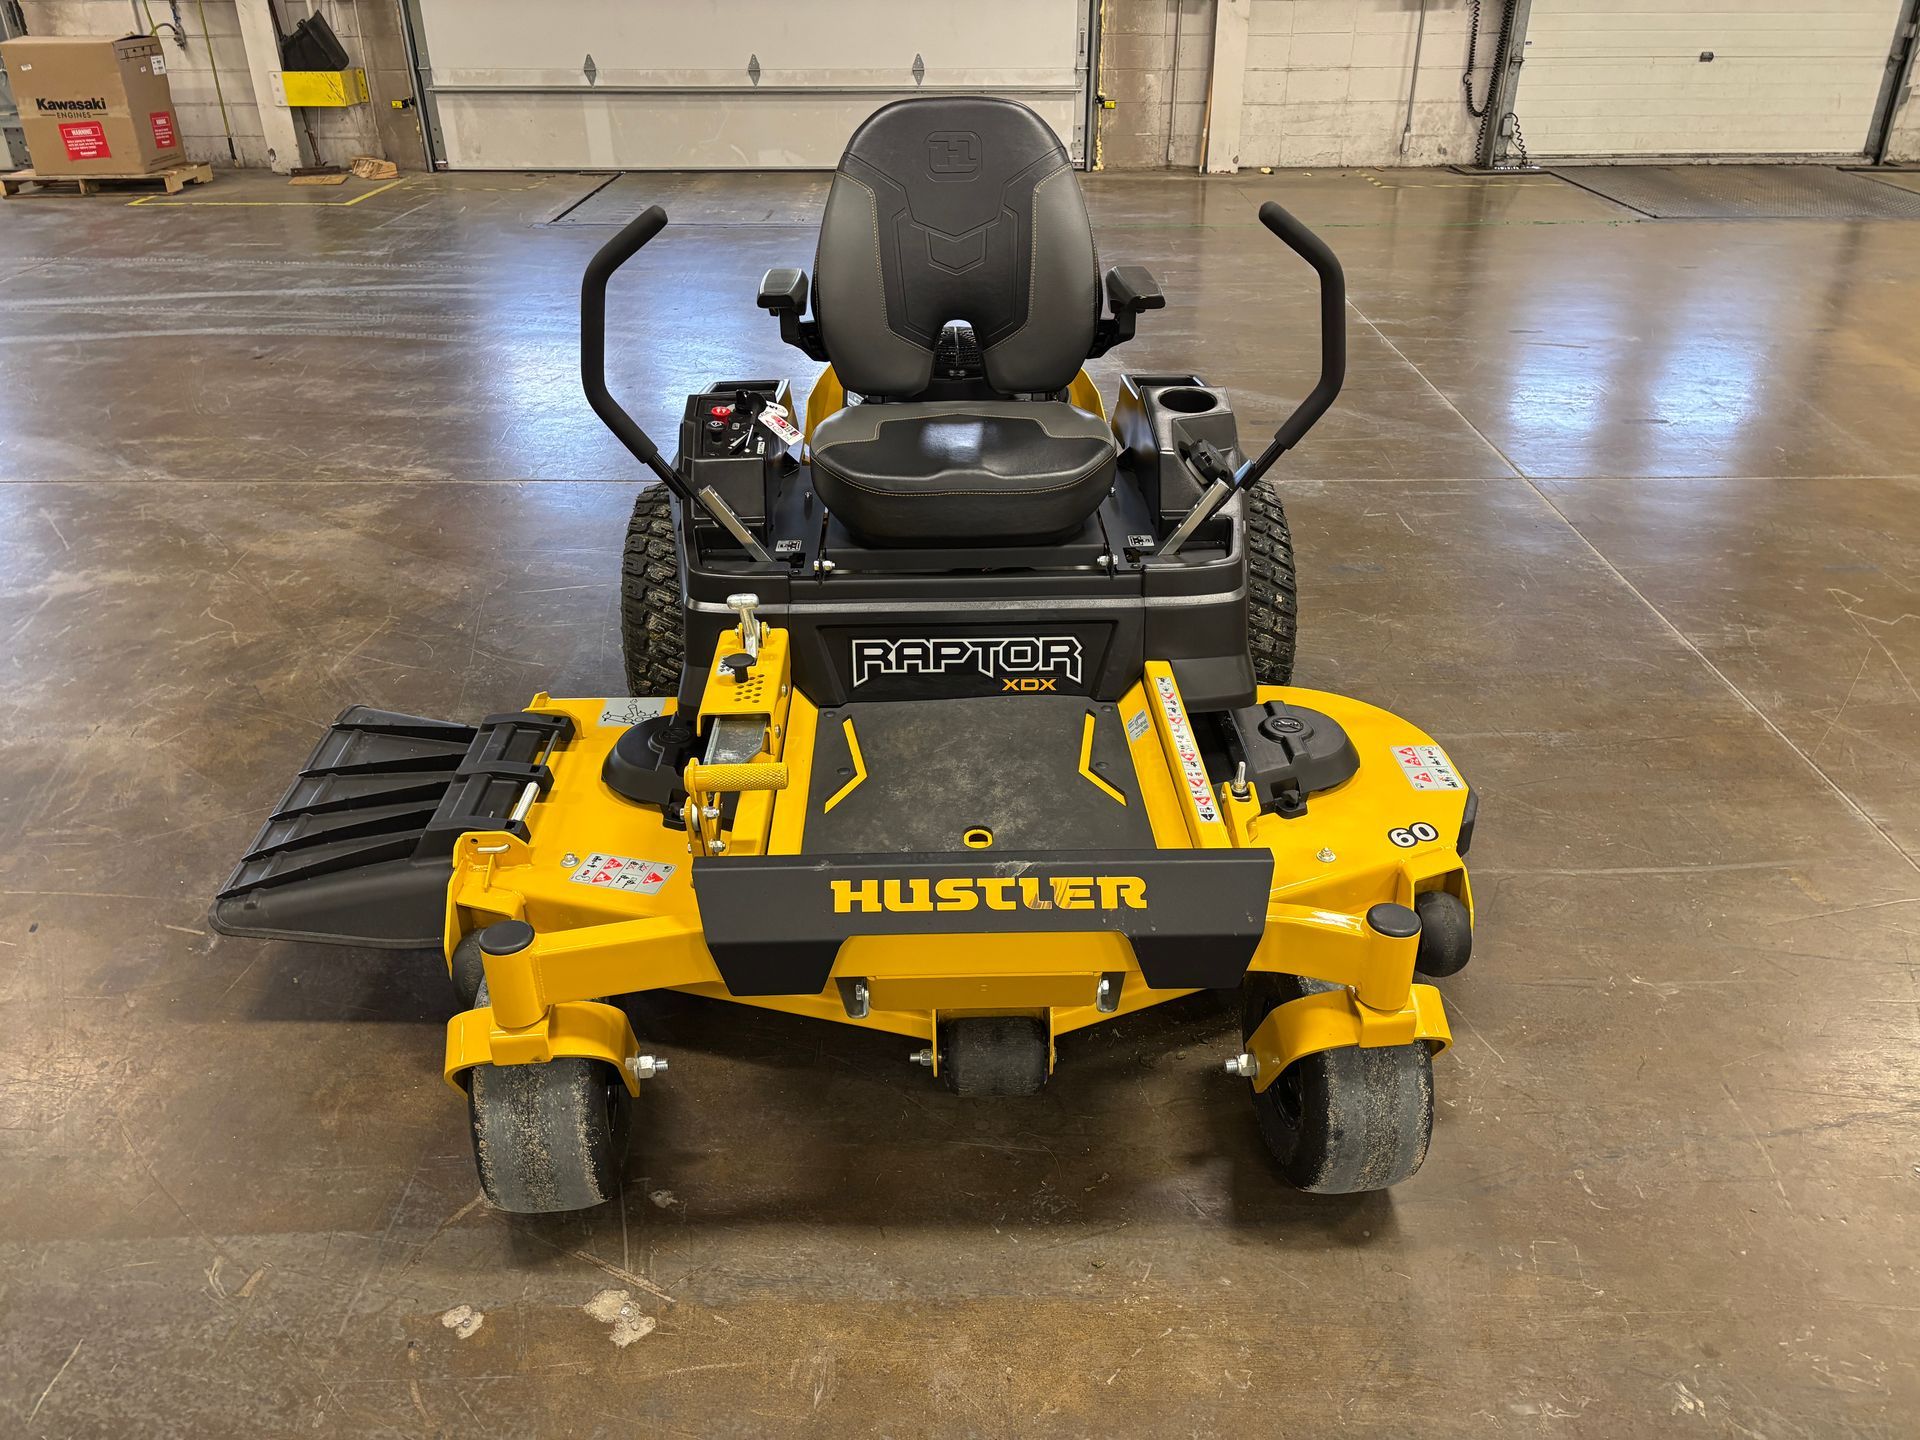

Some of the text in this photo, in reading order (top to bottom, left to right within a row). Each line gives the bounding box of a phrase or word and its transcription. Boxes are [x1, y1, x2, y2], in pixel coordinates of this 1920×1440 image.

[35, 97, 107, 111] Kawasaki
[56, 111, 92, 119] ENGINES
[852, 636, 1083, 688] RAPTOR
[1001, 678, 1057, 692] XDX
[1388, 822, 1439, 848] 60
[830, 876, 1148, 914] HUSTLER
